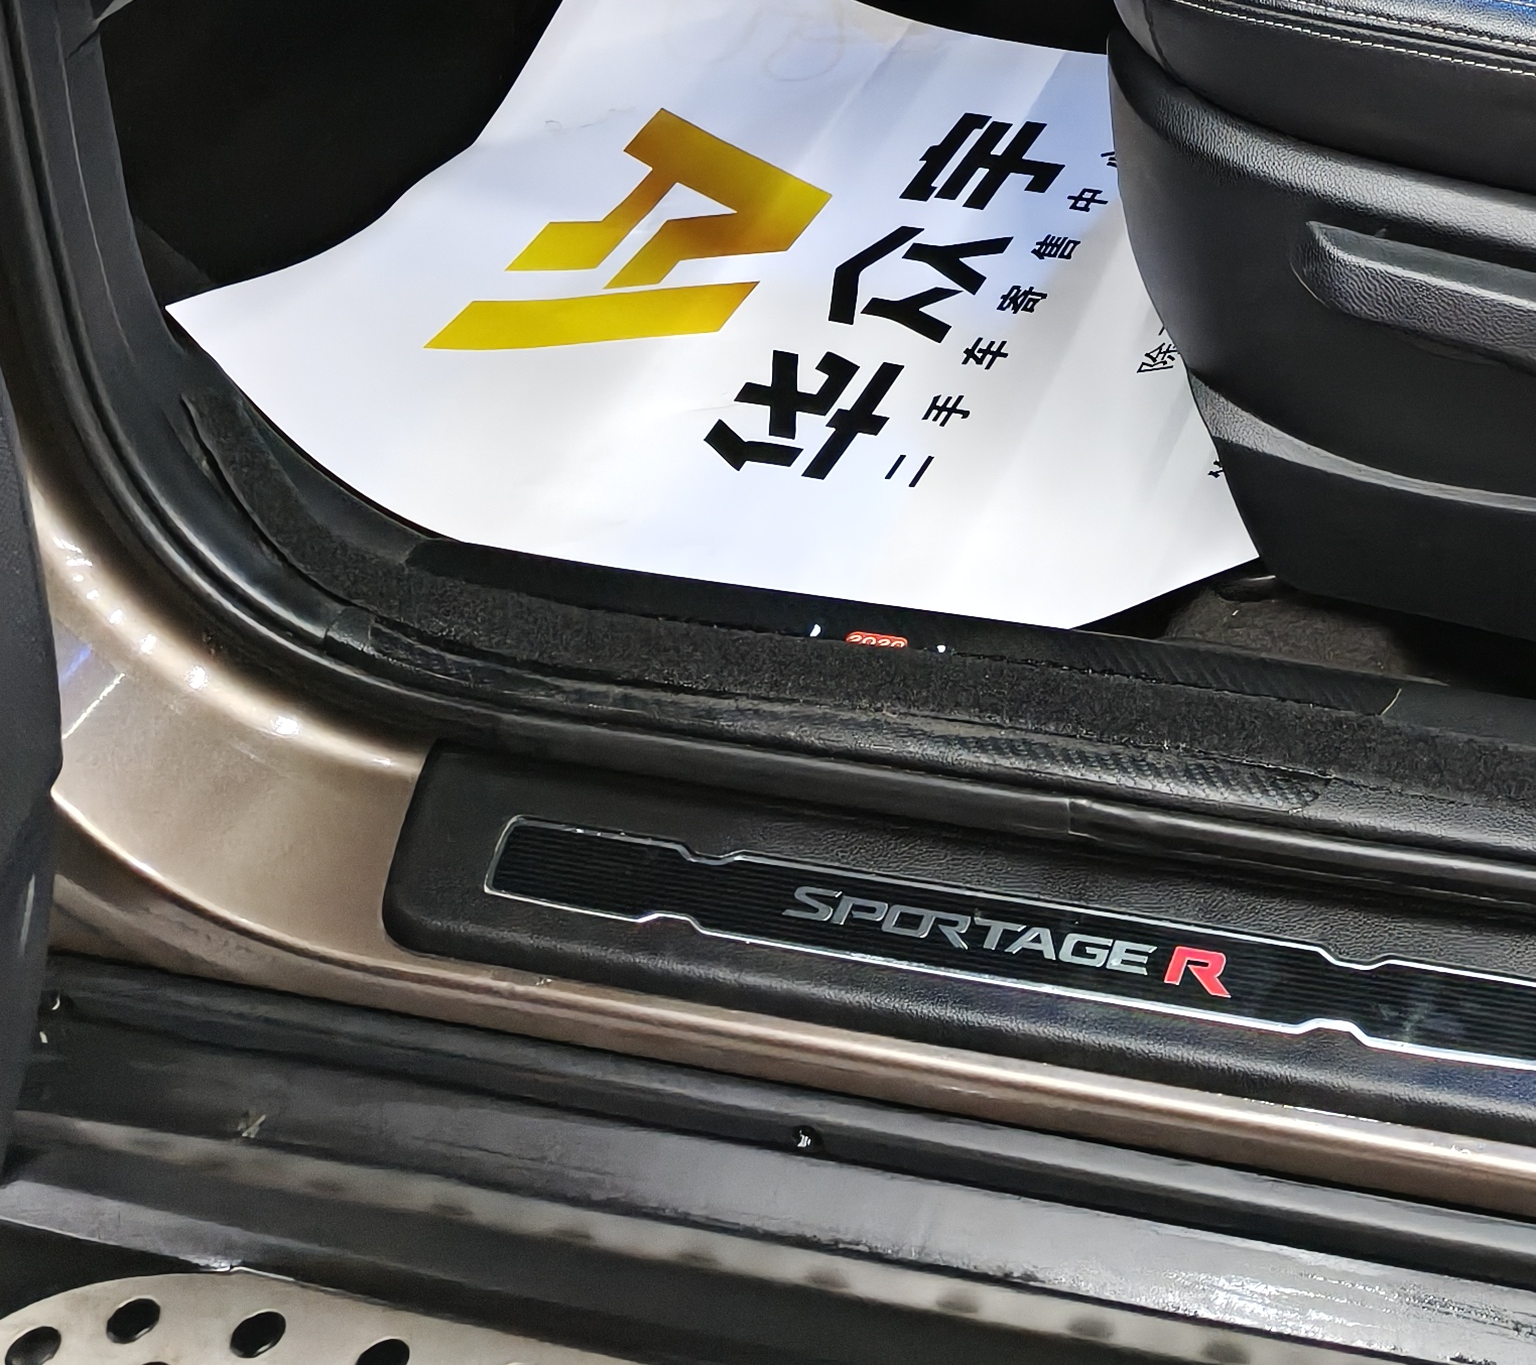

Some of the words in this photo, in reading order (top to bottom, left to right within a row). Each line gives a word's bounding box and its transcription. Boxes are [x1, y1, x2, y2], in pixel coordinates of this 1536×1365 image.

[704, 112, 1065, 481] 华众宇
[782, 885, 1157, 975] SPORTAGE
[1164, 945, 1232, 999] R
